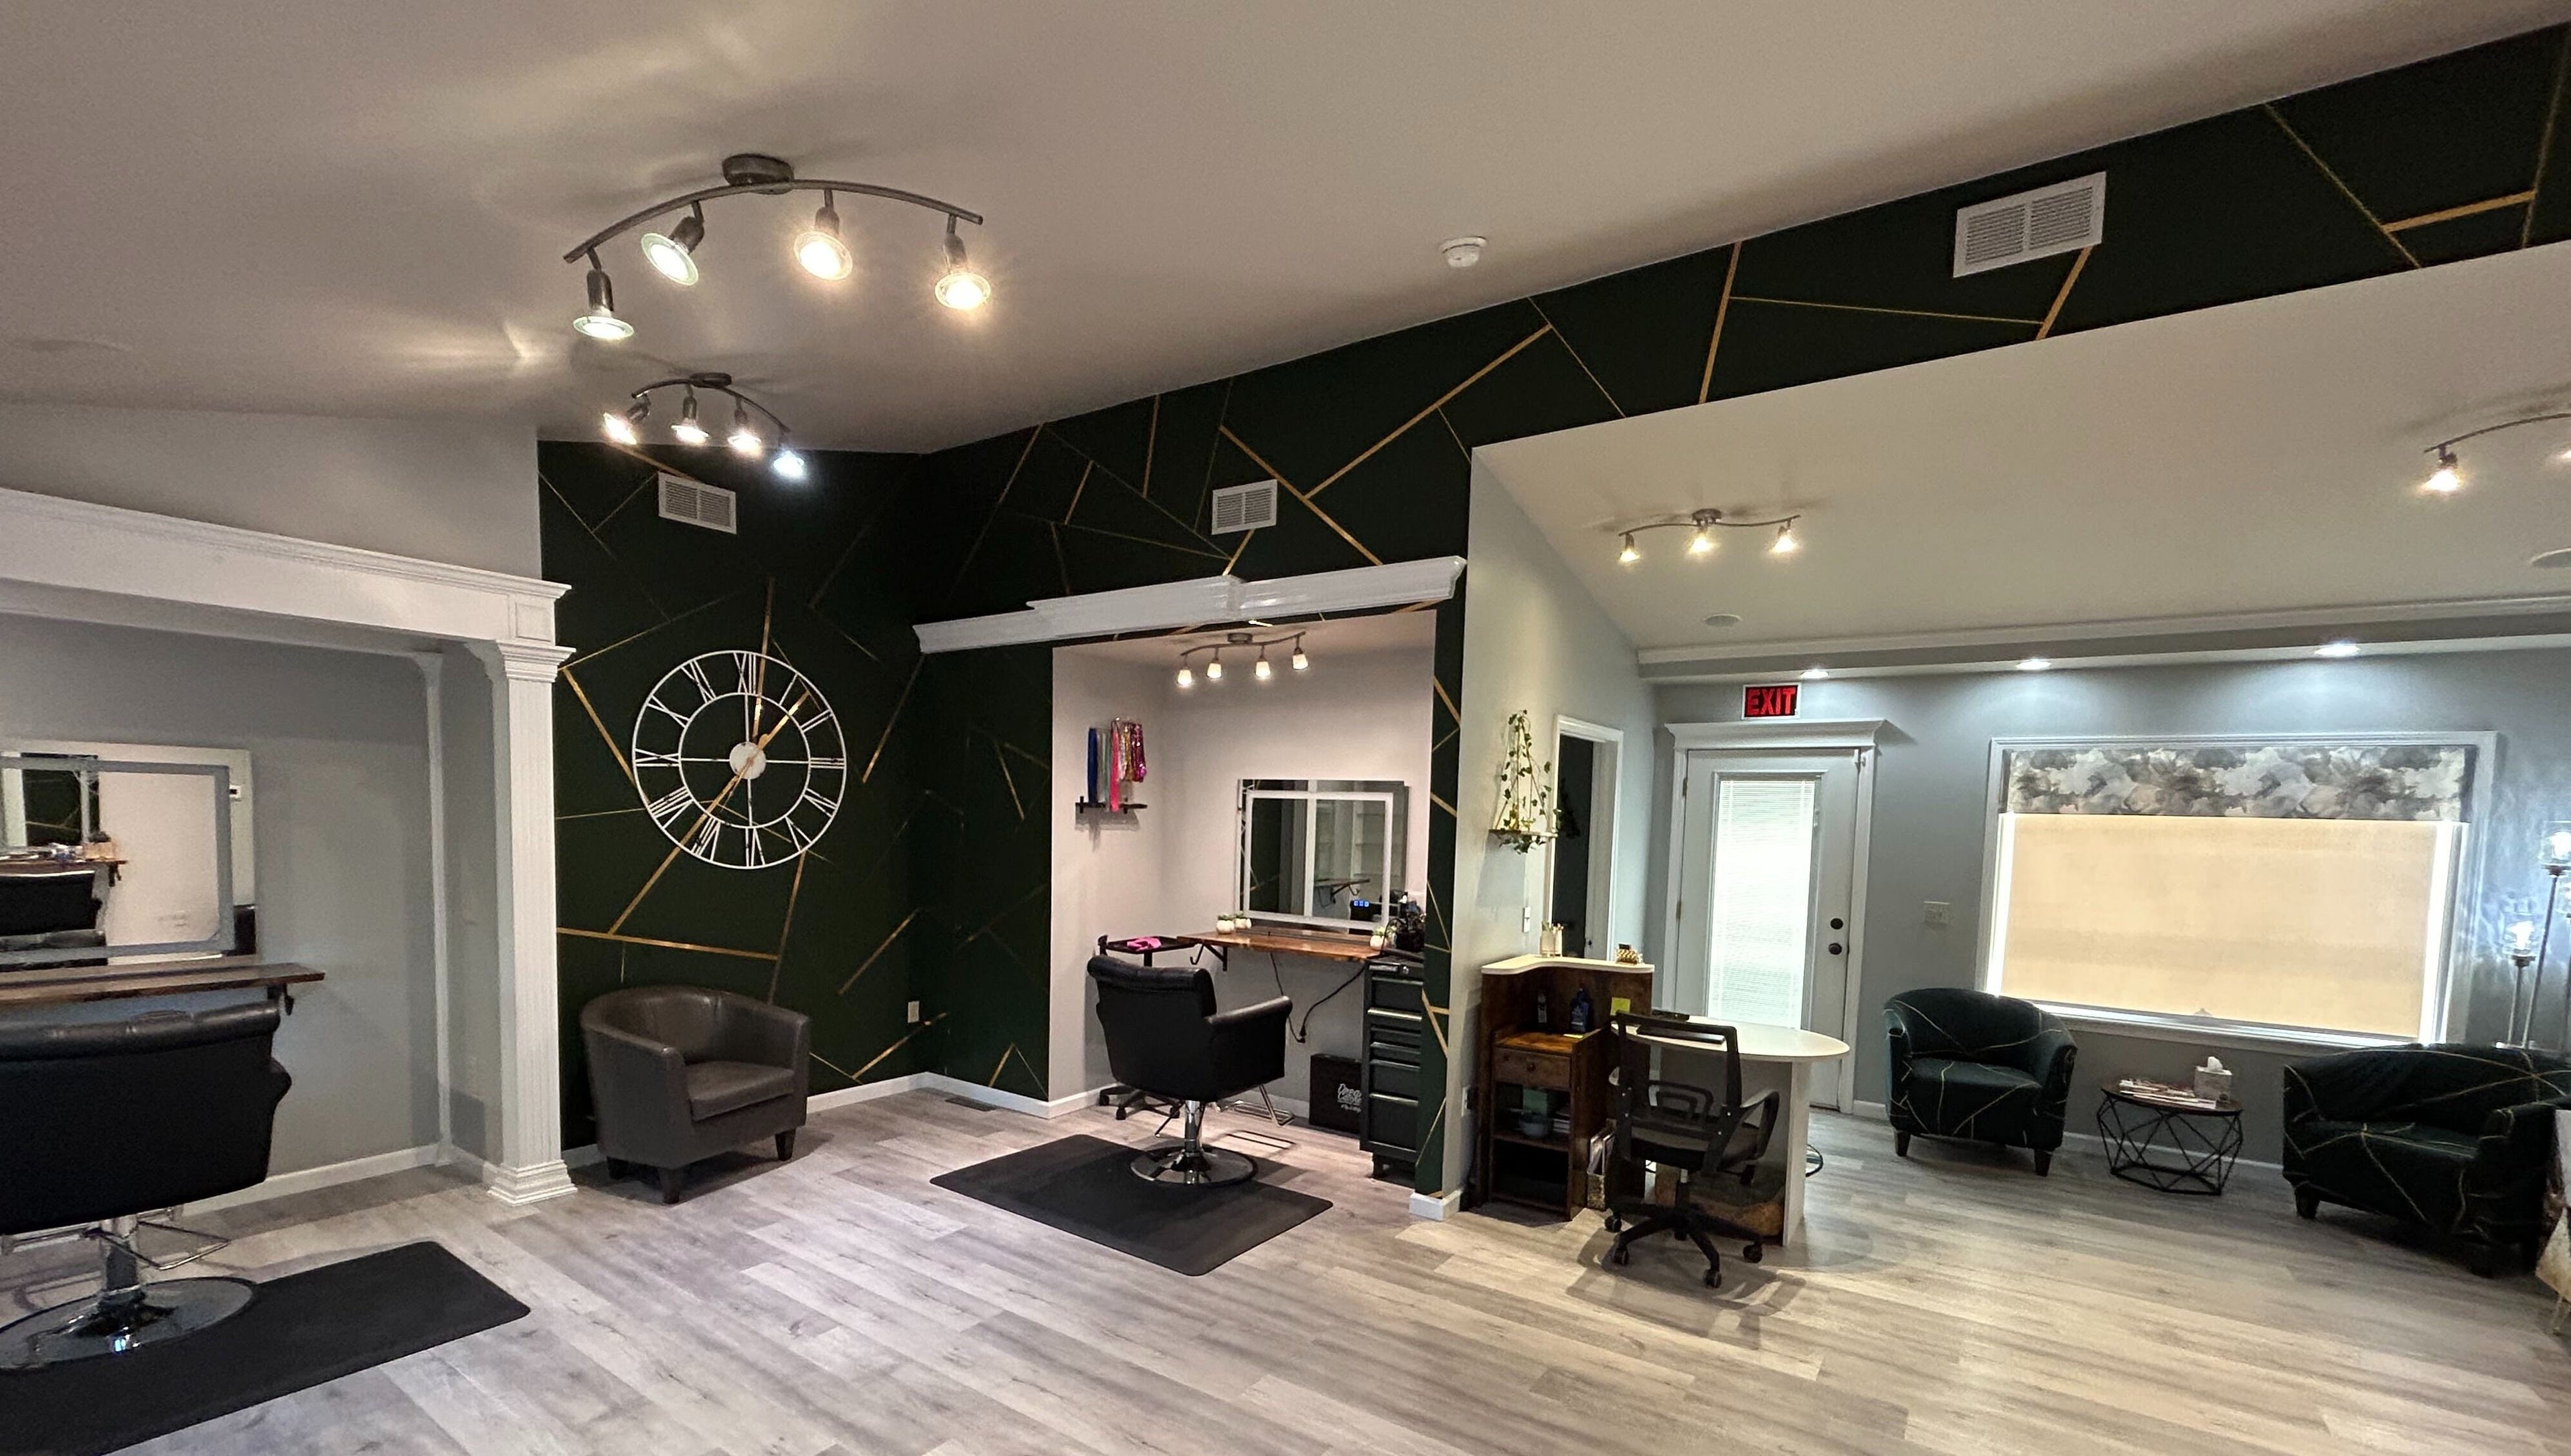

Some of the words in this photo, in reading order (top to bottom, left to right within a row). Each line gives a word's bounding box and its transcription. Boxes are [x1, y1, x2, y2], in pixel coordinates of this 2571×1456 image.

[680, 660, 716, 703] XI
[734, 652, 757, 694] XII
[779, 673, 799, 706] I
[647, 696, 690, 728] X
[1747, 687, 1795, 715] EXIT
[800, 709, 833, 732] II
[635, 748, 680, 766] IX
[809, 757, 844, 769] III
[649, 786, 693, 829] VIII
[804, 789, 838, 817] IV
[692, 817, 720, 862] VII
[745, 828, 765, 867] VI
[785, 815, 812, 851] V
